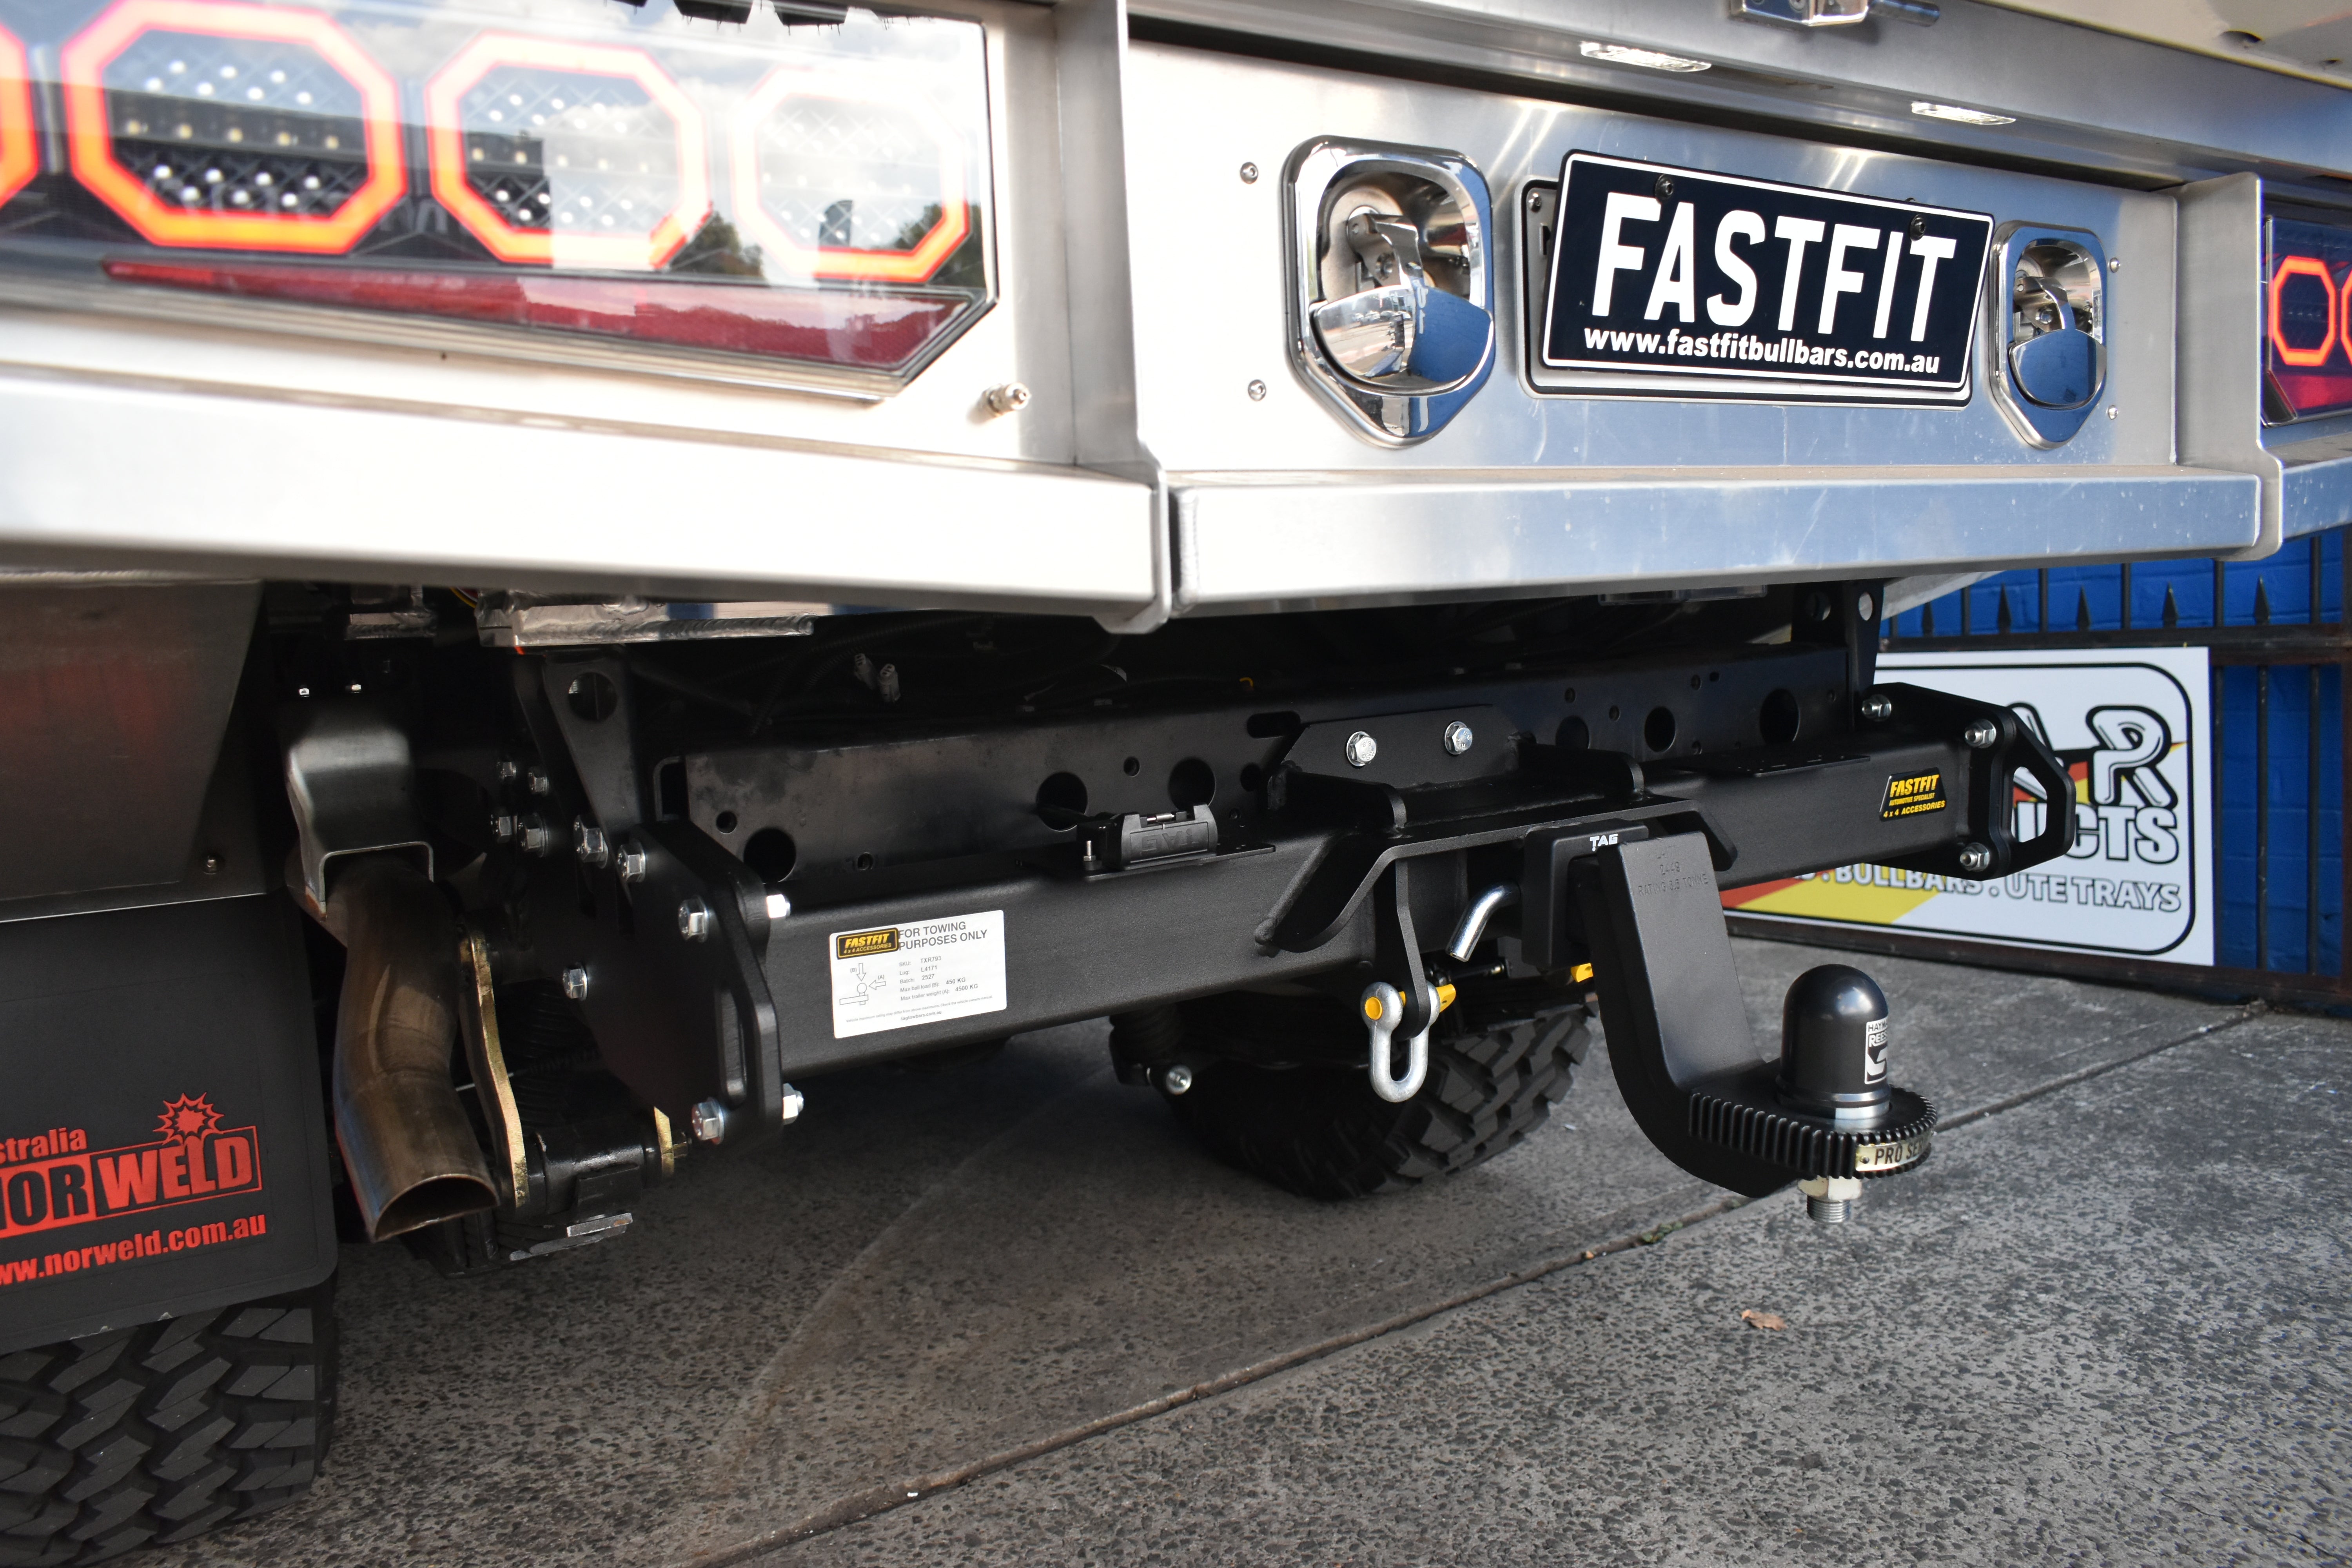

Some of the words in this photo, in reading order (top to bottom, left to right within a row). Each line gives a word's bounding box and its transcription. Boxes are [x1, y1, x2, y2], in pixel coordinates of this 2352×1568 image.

[1592, 192, 1956, 342] FASTFIT
[1584, 325, 1940, 374] www.fastfitbullbars.com.au
[1889, 774, 1940, 798] FASTFIT
[1889, 796, 1913, 806] AUTOMOTIVE
[1914, 792, 1935, 802] SPECIALIST
[1901, 800, 1945, 815] ACCESSORIES
[1590, 833, 1619, 851] TAG
[1682, 874, 1708, 887] TONNE
[2004, 872, 2067, 903] UTE
[2071, 876, 2182, 913] TRAYS
[898, 928, 920, 939] FOR
[923, 921, 966, 935] TOWING
[845, 933, 890, 948] FASTFIT
[856, 943, 892, 952] ACCESSORIES
[899, 934, 957, 951] PURPOSES
[960, 929, 987, 942] ONLY
[901, 1011, 942, 1021] tagtowbars.com.au
[1875, 1142, 1903, 1165] PRO
